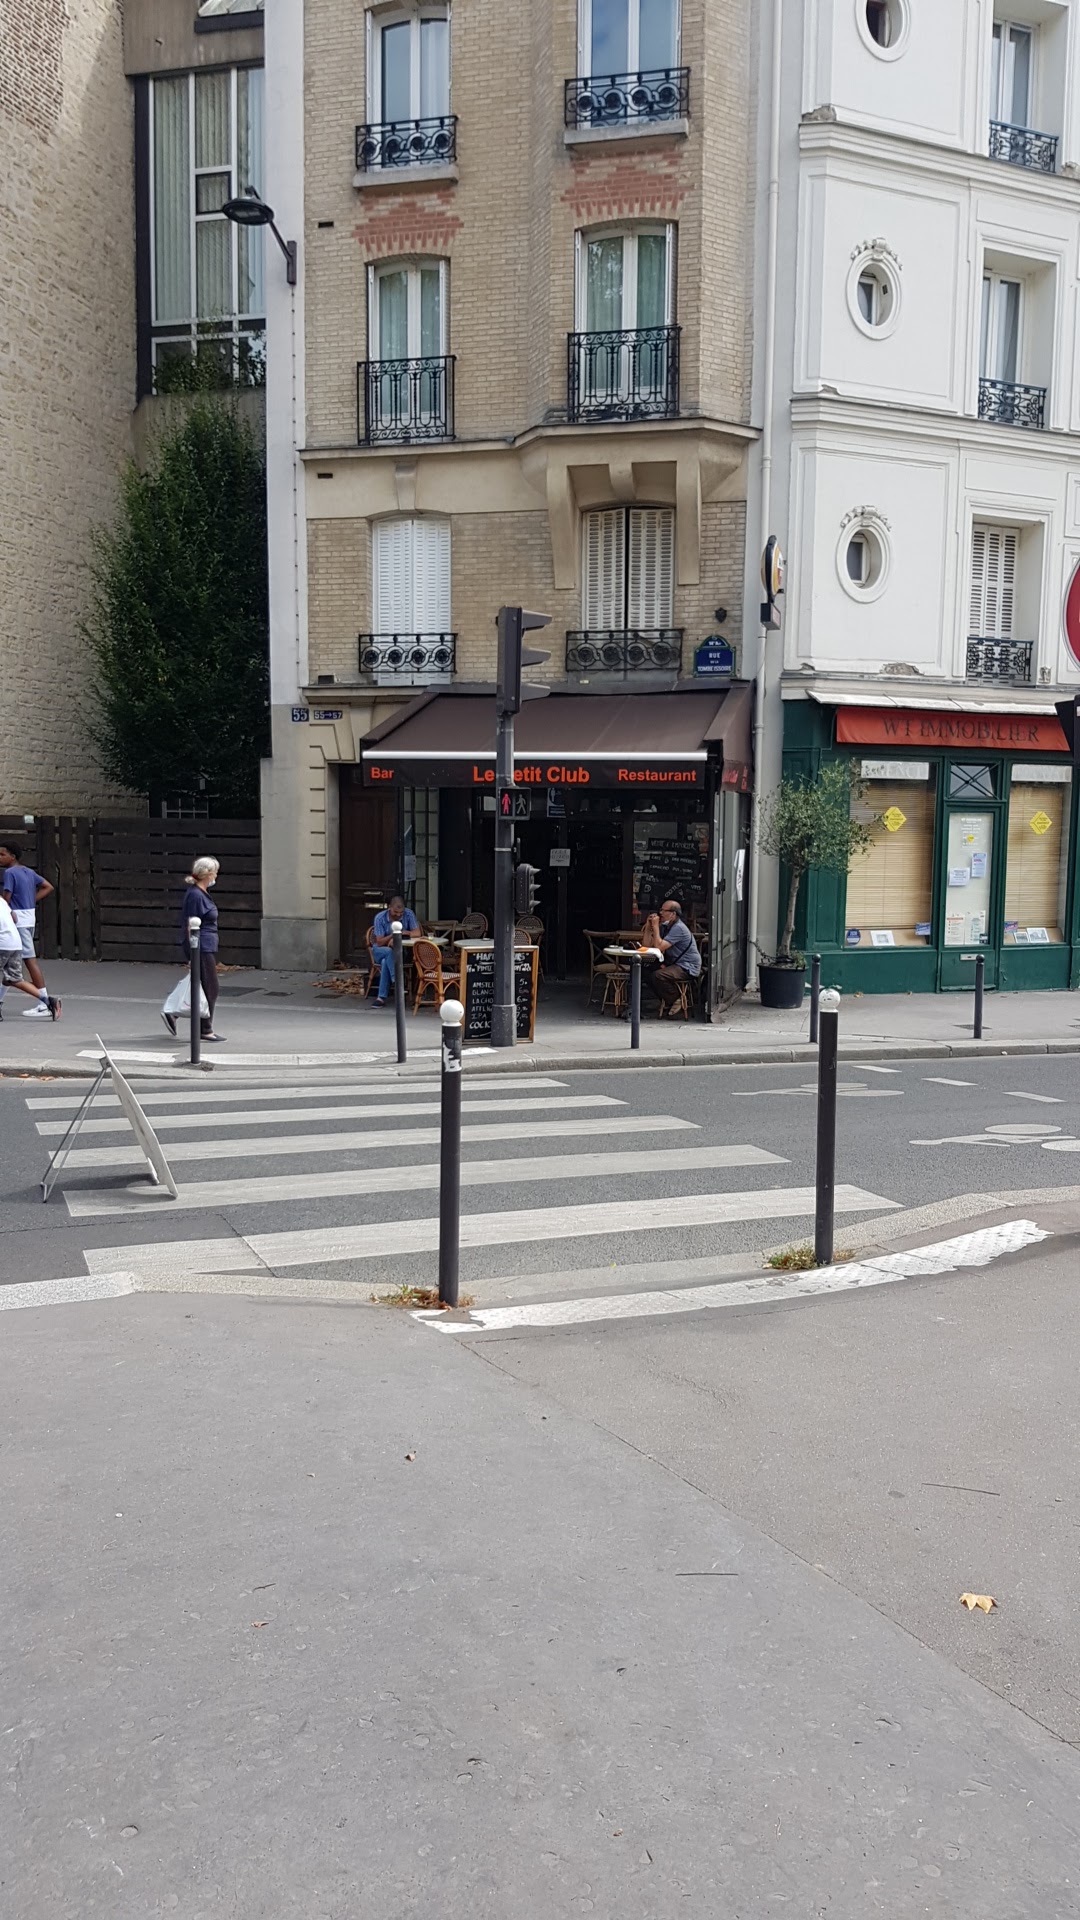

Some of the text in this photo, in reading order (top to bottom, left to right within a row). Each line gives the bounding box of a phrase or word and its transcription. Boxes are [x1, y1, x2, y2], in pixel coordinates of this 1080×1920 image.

[293, 708, 308, 721] 55
[883, 719, 1040, 743] WT IMMOBILIER
[370, 766, 395, 779] Bar
[472, 765, 590, 783] Le etit Club
[617, 768, 697, 782] Restaurant
